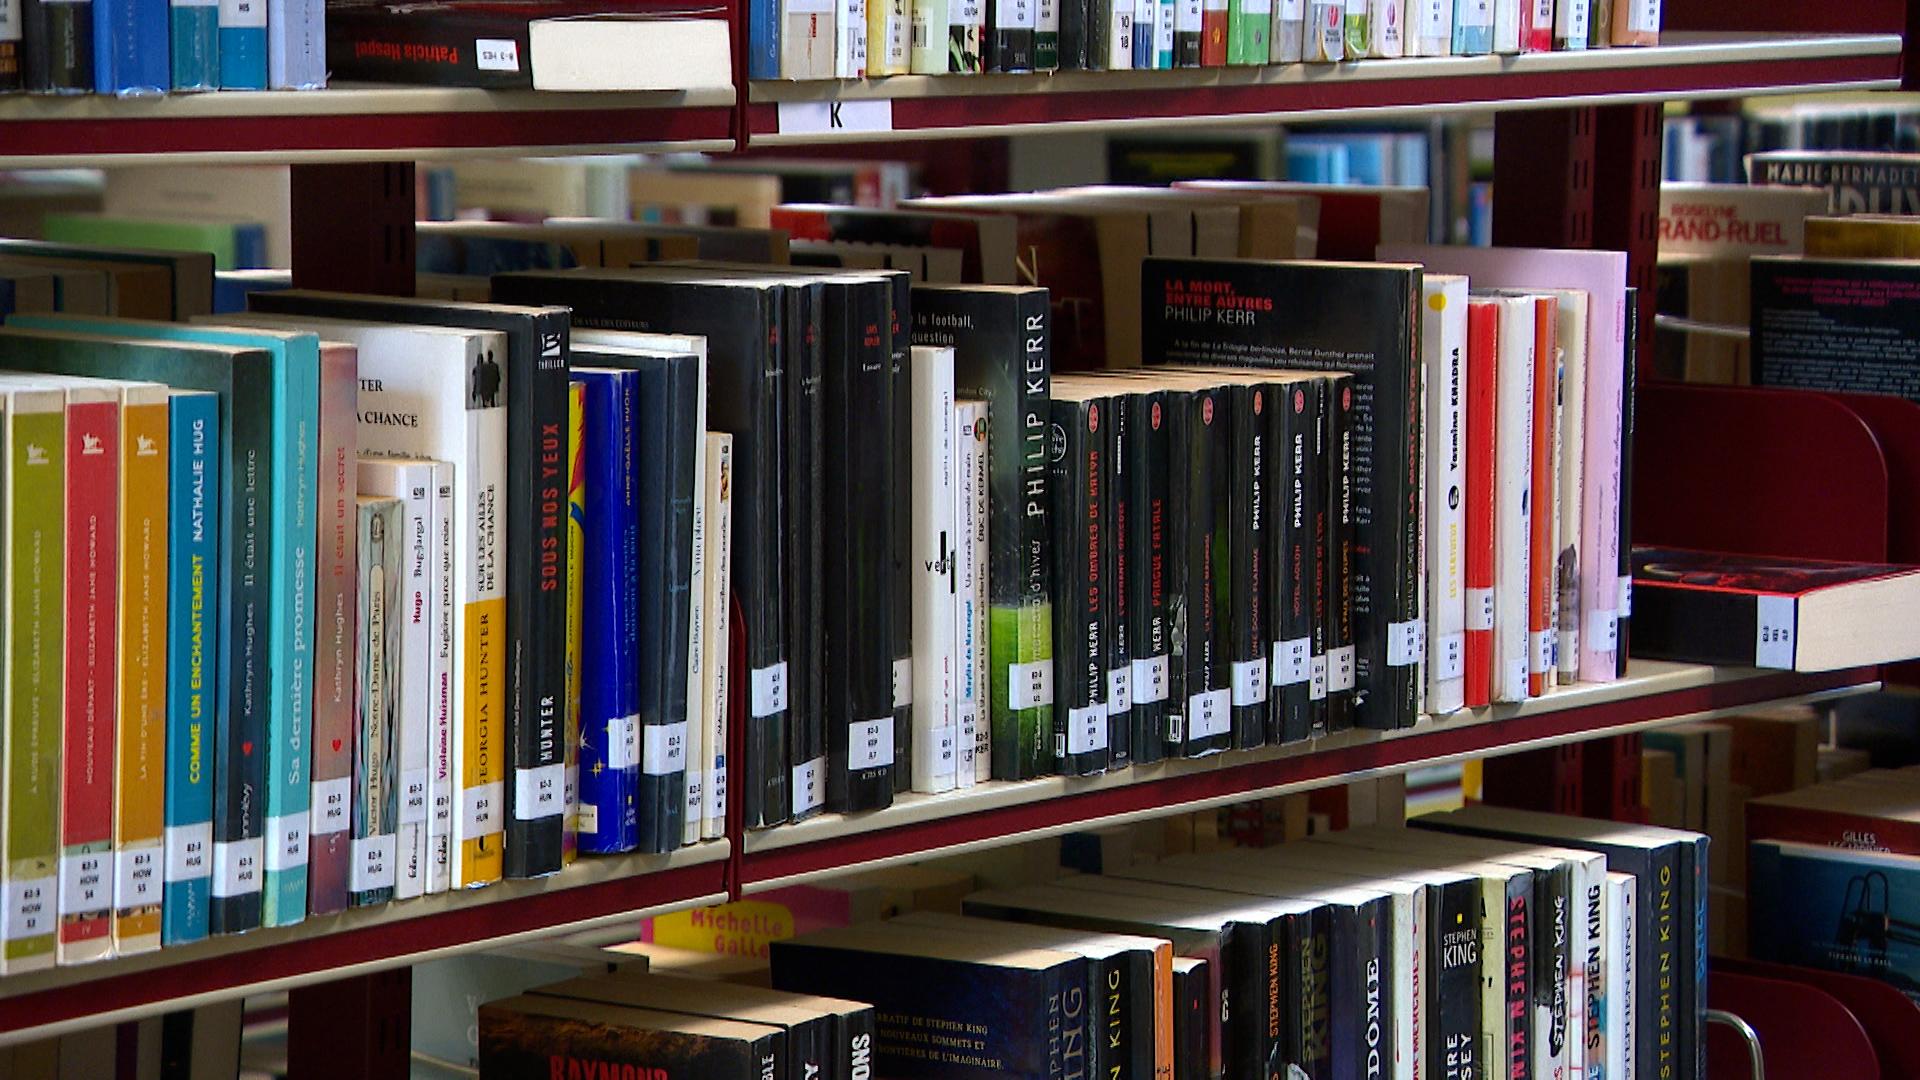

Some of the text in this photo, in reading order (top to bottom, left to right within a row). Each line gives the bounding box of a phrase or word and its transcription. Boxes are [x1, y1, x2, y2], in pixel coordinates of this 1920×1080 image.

[354, 40, 459, 65] Patricia Hespel
[829, 102, 843, 128] K
[931, 312, 975, 331] football,
[1165, 293, 1273, 311] ENTRE AUTRES
[1165, 305, 1255, 326] PHILIP KERR
[1166, 280, 1236, 296] LA MORT,
[912, 333, 955, 348] question
[1289, 347, 1375, 361] Bernie Gunther prenait
[1451, 347, 1460, 406] KHADRA
[364, 411, 418, 428] CHANCE
[1026, 313, 1045, 516] PHILIP KERR
[542, 423, 559, 591] SOUS NOS YEUX
[976, 452, 986, 542] ÉRIC DE KERMEL
[1253, 435, 1261, 530] PHILIP KERR
[1294, 434, 1302, 528] PHILIP KERR
[333, 447, 346, 702] Kathryn Hughes était un secret
[412, 516, 425, 624] Hugo Bug-Jargal
[478, 491, 486, 592] SUR LES AILES
[487, 483, 495, 591] DE LA CHANCE
[1030, 540, 1042, 593] d'hiver
[1316, 545, 1323, 558] DE
[1450, 522, 1458, 598] LES VERTUEUX
[189, 419, 204, 783] COMME UN ENCHANTEMENT NATHALIE HUG
[243, 449, 257, 715] Kathryn Hughes était une lettre
[288, 420, 307, 784] Sa dernière promesse Kathryn Hughes
[1089, 450, 1099, 704] PHILIP KERR LES OMBRES DE KATYN
[1152, 499, 1162, 653] KERR PRAGUE FATALE
[1293, 584, 1301, 617] HÔTEL
[87, 515, 97, 784] NOUVEAU JANE HOWARD
[438, 517, 450, 779] Violaine Huisman parce reine
[479, 613, 489, 694] HUNTER
[692, 605, 701, 674] Claire Huynen
[965, 600, 974, 646] Kerangal
[965, 649, 973, 660] de
[1342, 626, 1348, 640] LA
[369, 591, 381, 834] Victor Hugo Notre-Dame de Paris
[965, 663, 973, 698] Maylis
[540, 695, 554, 761] HUNTER
[407, 855, 417, 879] folio
[1842, 831, 1876, 845] GILLES
[690, 908, 784, 937] Michelle
[714, 934, 769, 960] Galle
[1443, 928, 1478, 946] STEPHEN
[1443, 942, 1478, 969] KING
[1510, 895, 1526, 1018] STEPHEN
[1268, 943, 1279, 1037] STEPHEN KING
[1301, 937, 1312, 1063] STEPHEN
[1312, 934, 1328, 1061] KING
[1553, 895, 1565, 1046] STEPHEN KING
[1588, 884, 1601, 1050] STEPHEN KING
[1624, 915, 1632, 1080] STEPHEN KING
[1660, 865, 1671, 1078] STEPHEN KING
[881, 1028, 986, 1051] NOUVEAUX SOMMETS ET
[912, 1016, 988, 1037] DE STEPHEN KING
[1108, 969, 1121, 1048] KING
[1363, 957, 1380, 1075] DÔME
[928, 1049, 1005, 1071] DE L'IMAGINAIRE.
